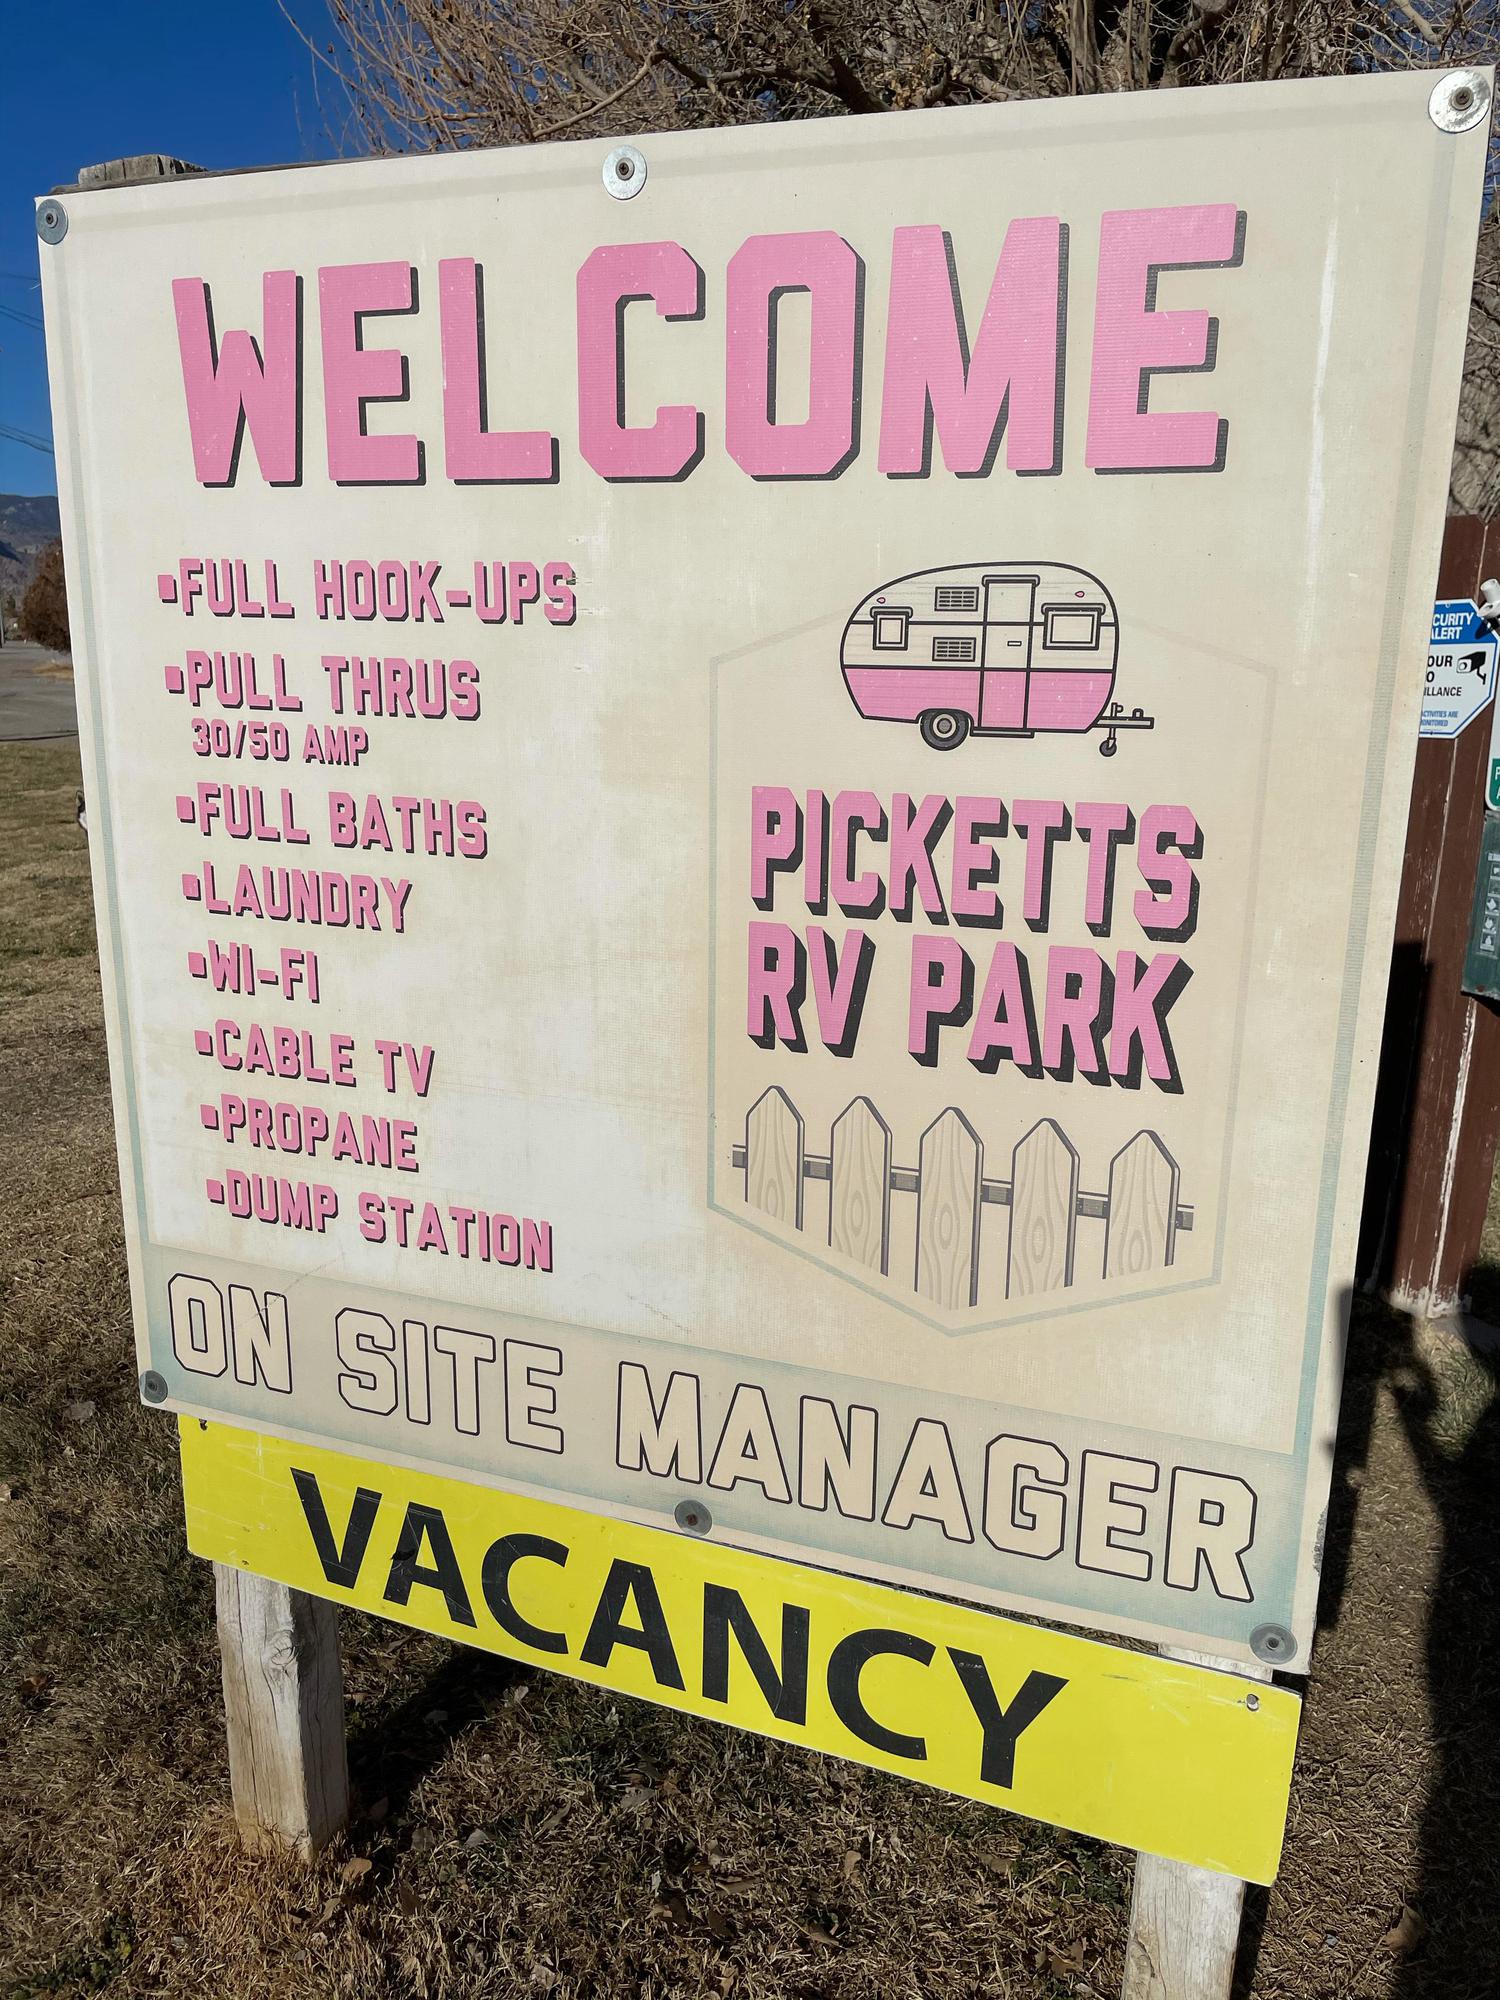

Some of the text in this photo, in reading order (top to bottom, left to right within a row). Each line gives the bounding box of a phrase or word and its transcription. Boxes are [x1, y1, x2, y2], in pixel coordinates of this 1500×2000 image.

[172, 203, 1247, 487] WELCOME
[179, 558, 578, 624] FULL HOOK-UPS
[186, 651, 481, 720] PULL THRUS
[192, 717, 369, 766] 30/50 AMP
[197, 782, 489, 859] FULL BATHS
[202, 860, 412, 933] LAUNDRY
[751, 785, 1205, 944] PICKETTS
[208, 940, 320, 1004] WI-FI
[747, 920, 1194, 1095] RV PARK
[214, 1019, 436, 1098] CABLE TV
[220, 1094, 420, 1172] PROPANE
[226, 1169, 554, 1273] DUMP STATION
[167, 1272, 1258, 1603] ON SITE MANAGER
[290, 1466, 1069, 1790] VACANCY
